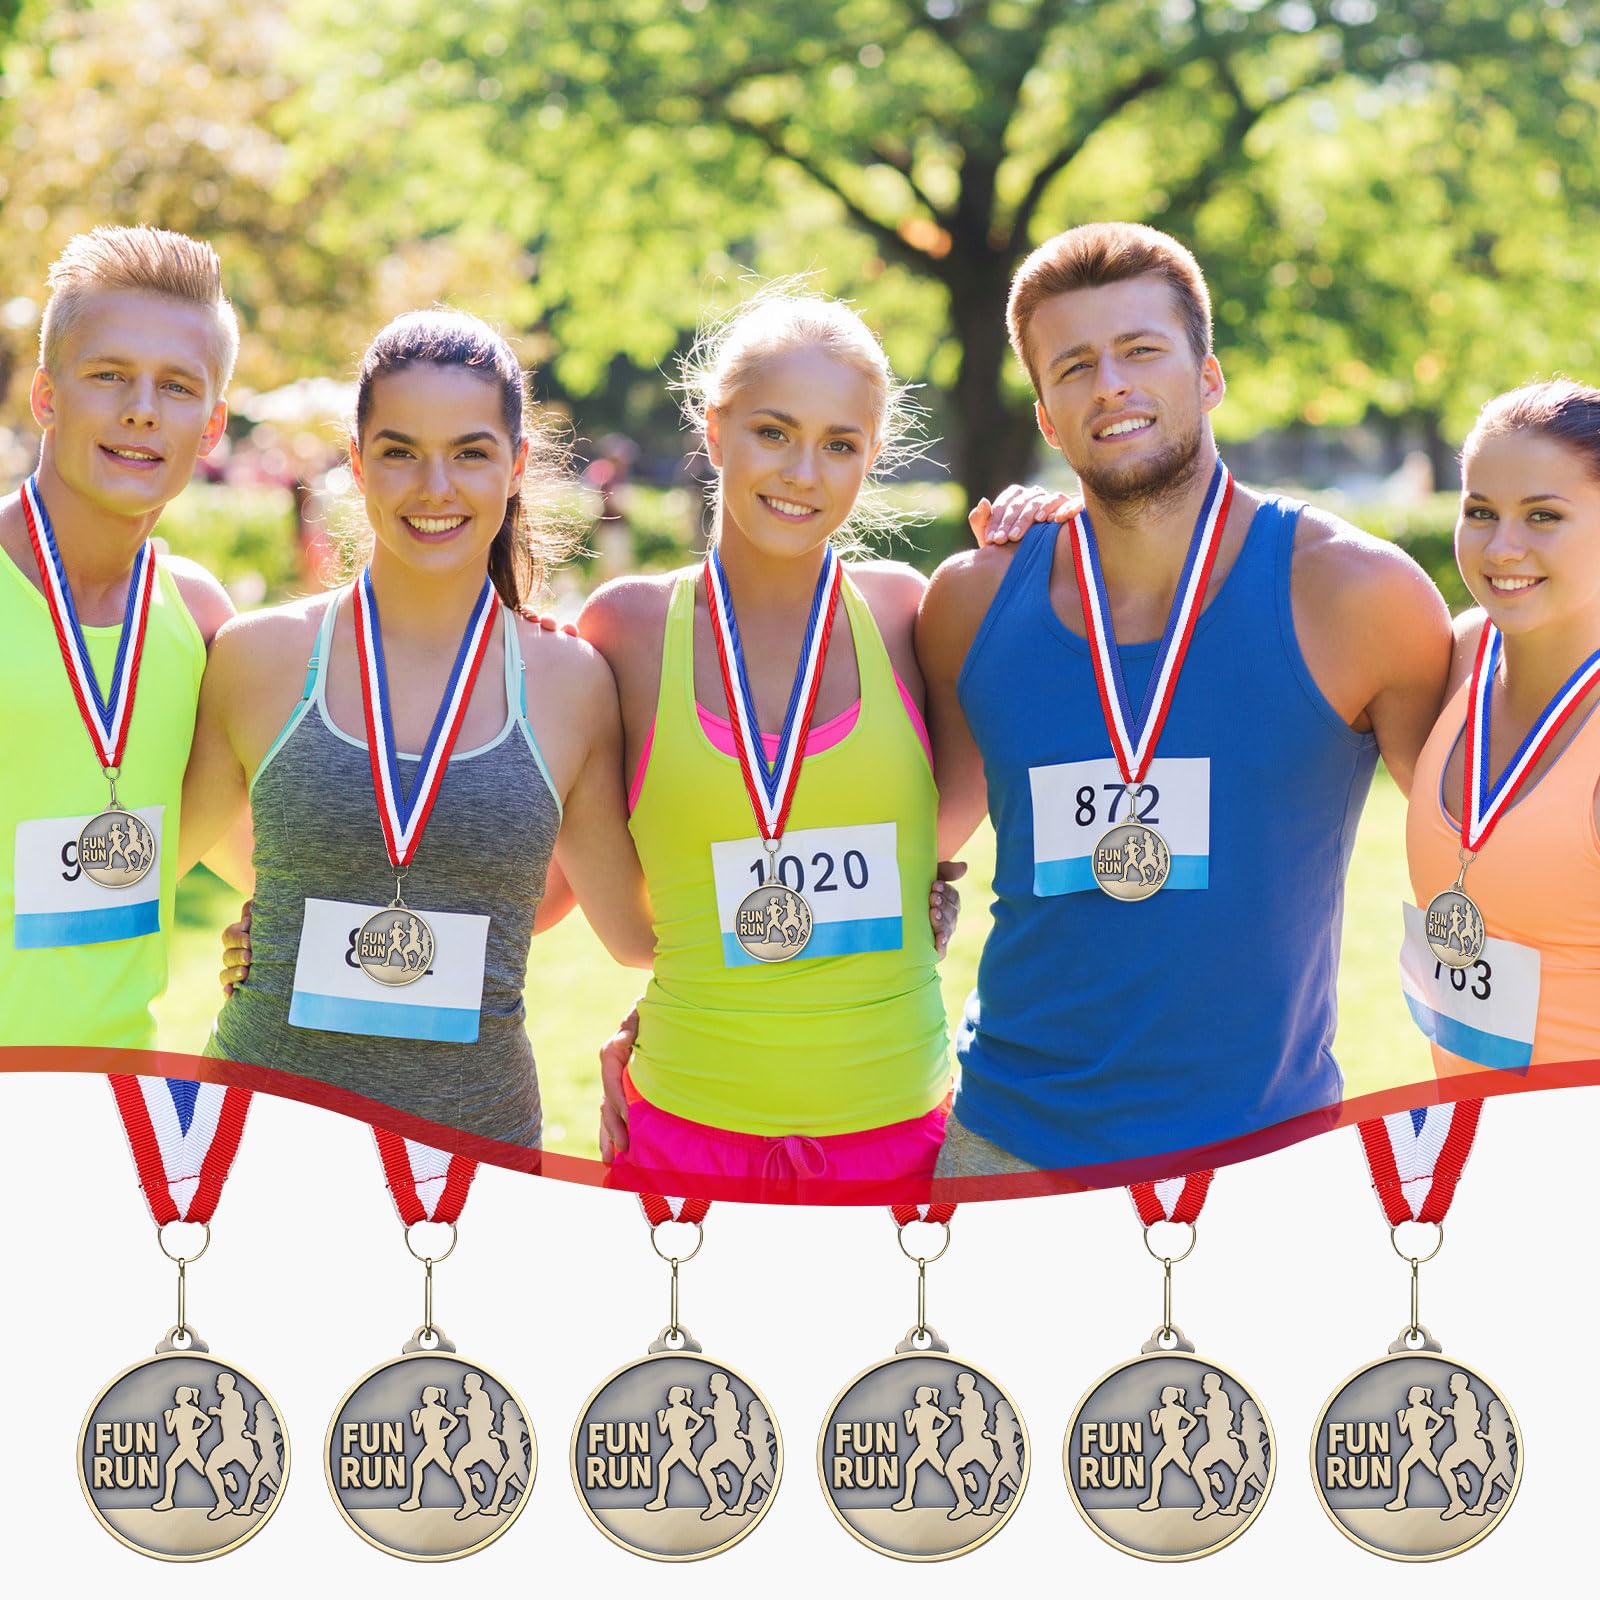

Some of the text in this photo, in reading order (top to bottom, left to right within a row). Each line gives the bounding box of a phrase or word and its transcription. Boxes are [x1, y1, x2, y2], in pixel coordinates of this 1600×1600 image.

[1075, 784, 1160, 827] 872
[81, 849, 108, 862] RUN
[82, 836, 106, 850] FUN
[1098, 849, 1121, 862] FUN
[749, 849, 869, 893] 1020
[1097, 862, 1122, 875] RUN
[739, 922, 764, 936] RUN
[740, 910, 764, 923] FUN
[1428, 922, 1447, 939] RUN
[1429, 911, 1448, 926] FUN
[361, 944, 386, 958] RUN
[362, 931, 387, 946] FUN
[94, 1422, 157, 1454] FUN
[340, 1422, 404, 1454] FUN
[587, 1422, 650, 1454] FUN
[834, 1422, 896, 1454] FUN
[1080, 1422, 1143, 1454] FUN
[1326, 1422, 1390, 1454] FUN
[92, 1455, 160, 1489] RUN
[338, 1455, 406, 1489] RUN
[585, 1455, 653, 1489] RUN
[832, 1455, 900, 1489] RUN
[1078, 1455, 1146, 1489] RUN
[1324, 1455, 1392, 1489] RUN
